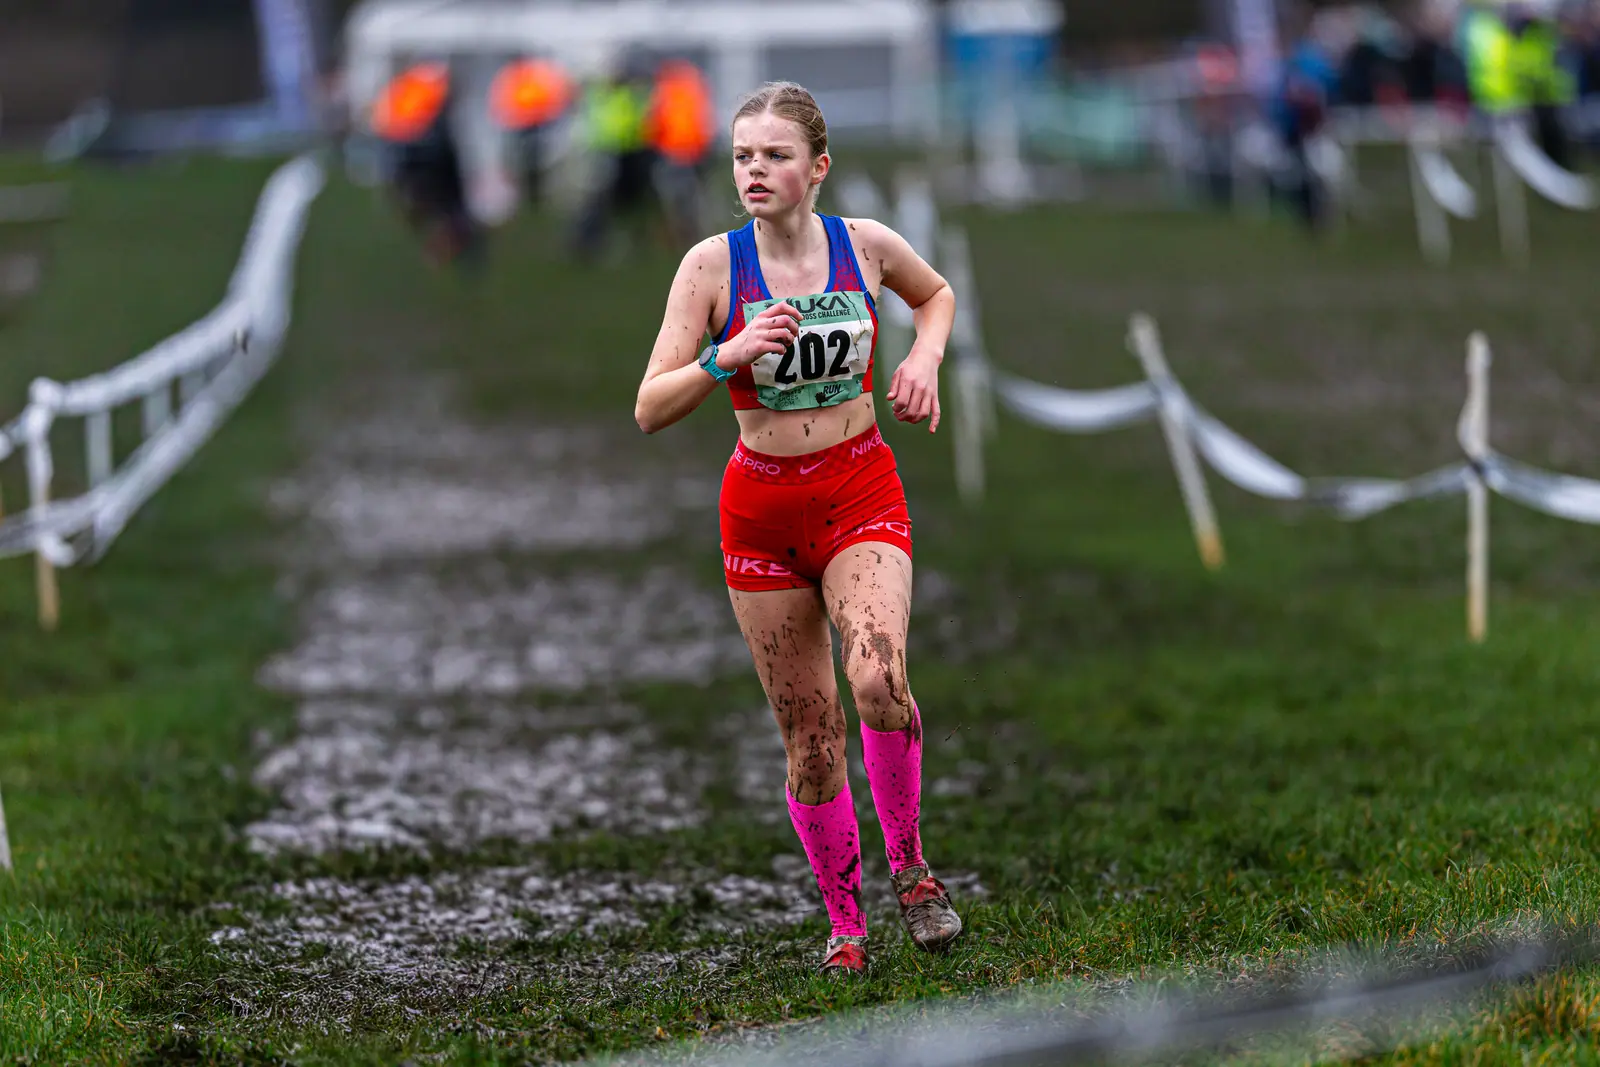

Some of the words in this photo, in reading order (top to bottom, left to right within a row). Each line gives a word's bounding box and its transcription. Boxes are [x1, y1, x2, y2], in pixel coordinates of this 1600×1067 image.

[818, 309, 851, 319] CHALLENGE
[774, 329, 852, 384] 202
[823, 384, 841, 394] RUN
[851, 430, 881, 459] NIKE
[743, 457, 781, 475] PRO
